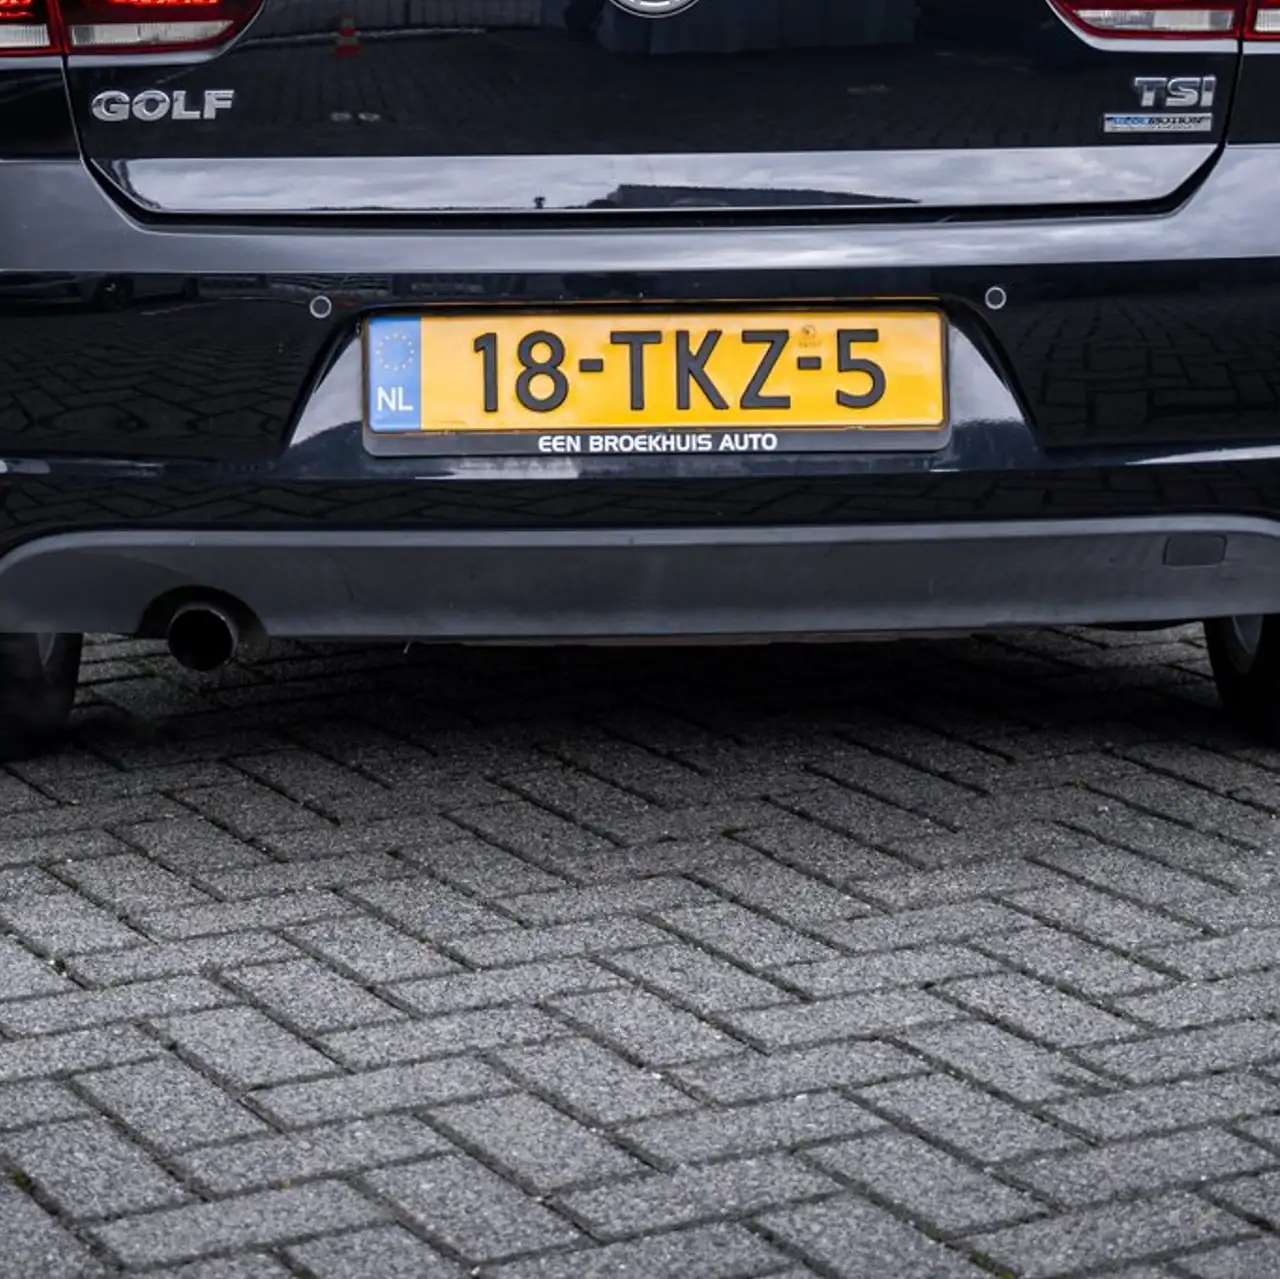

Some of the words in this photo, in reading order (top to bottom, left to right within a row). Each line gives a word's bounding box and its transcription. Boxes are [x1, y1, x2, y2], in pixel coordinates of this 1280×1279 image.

[91, 89, 235, 122] GOLF
[1134, 75, 1217, 107] TSI
[473, 328, 887, 413] 18-TKZ-5
[376, 386, 414, 413] NL
[537, 435, 582, 453] EEN
[588, 433, 713, 453] BROEKHUIS
[718, 432, 779, 452] AUTO
